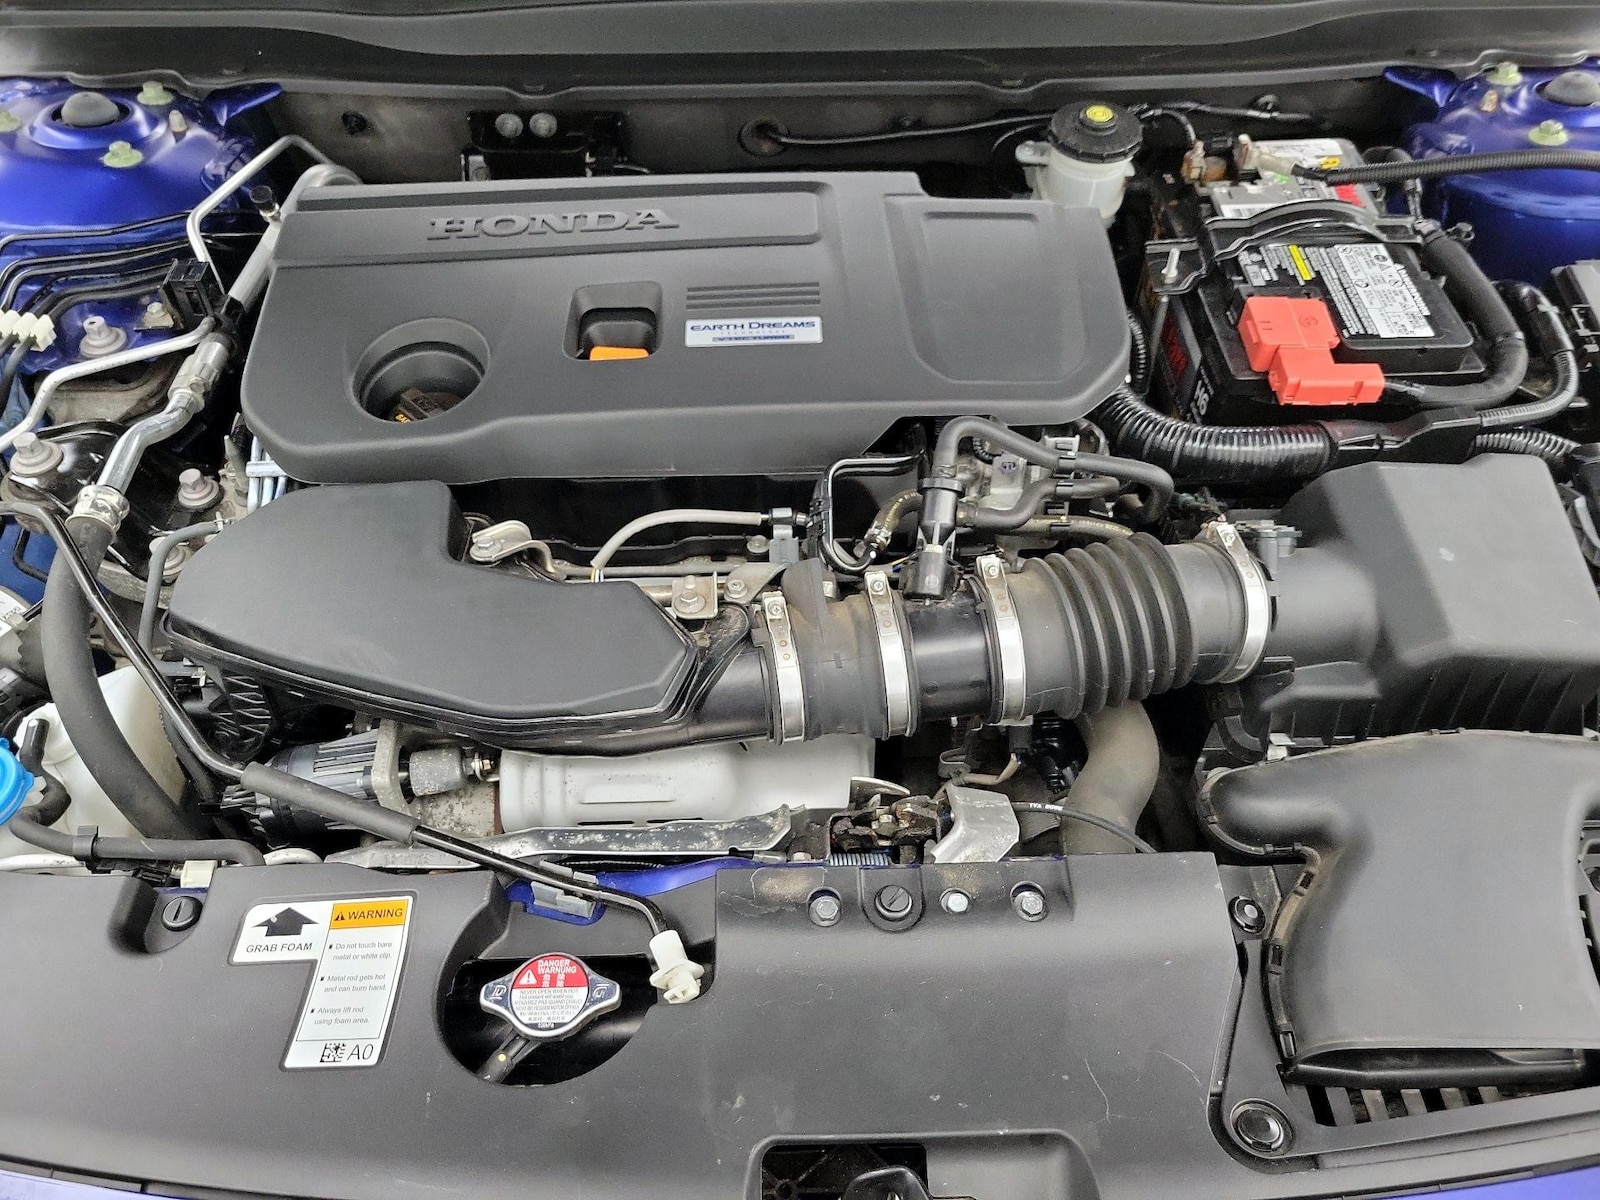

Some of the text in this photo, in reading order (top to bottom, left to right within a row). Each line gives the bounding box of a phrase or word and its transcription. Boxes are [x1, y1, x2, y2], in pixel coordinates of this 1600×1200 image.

[427, 208, 680, 241] HONDA
[690, 321, 816, 332] EARTH DREAMS
[347, 908, 404, 921] WARNING
[246, 942, 313, 953] GRAB FOAM
[538, 966, 577, 974] WARNUNG
[358, 974, 374, 982] gets
[317, 1007, 342, 1015] Always
[314, 1018, 332, 1026] using
[346, 1043, 374, 1061] A0
